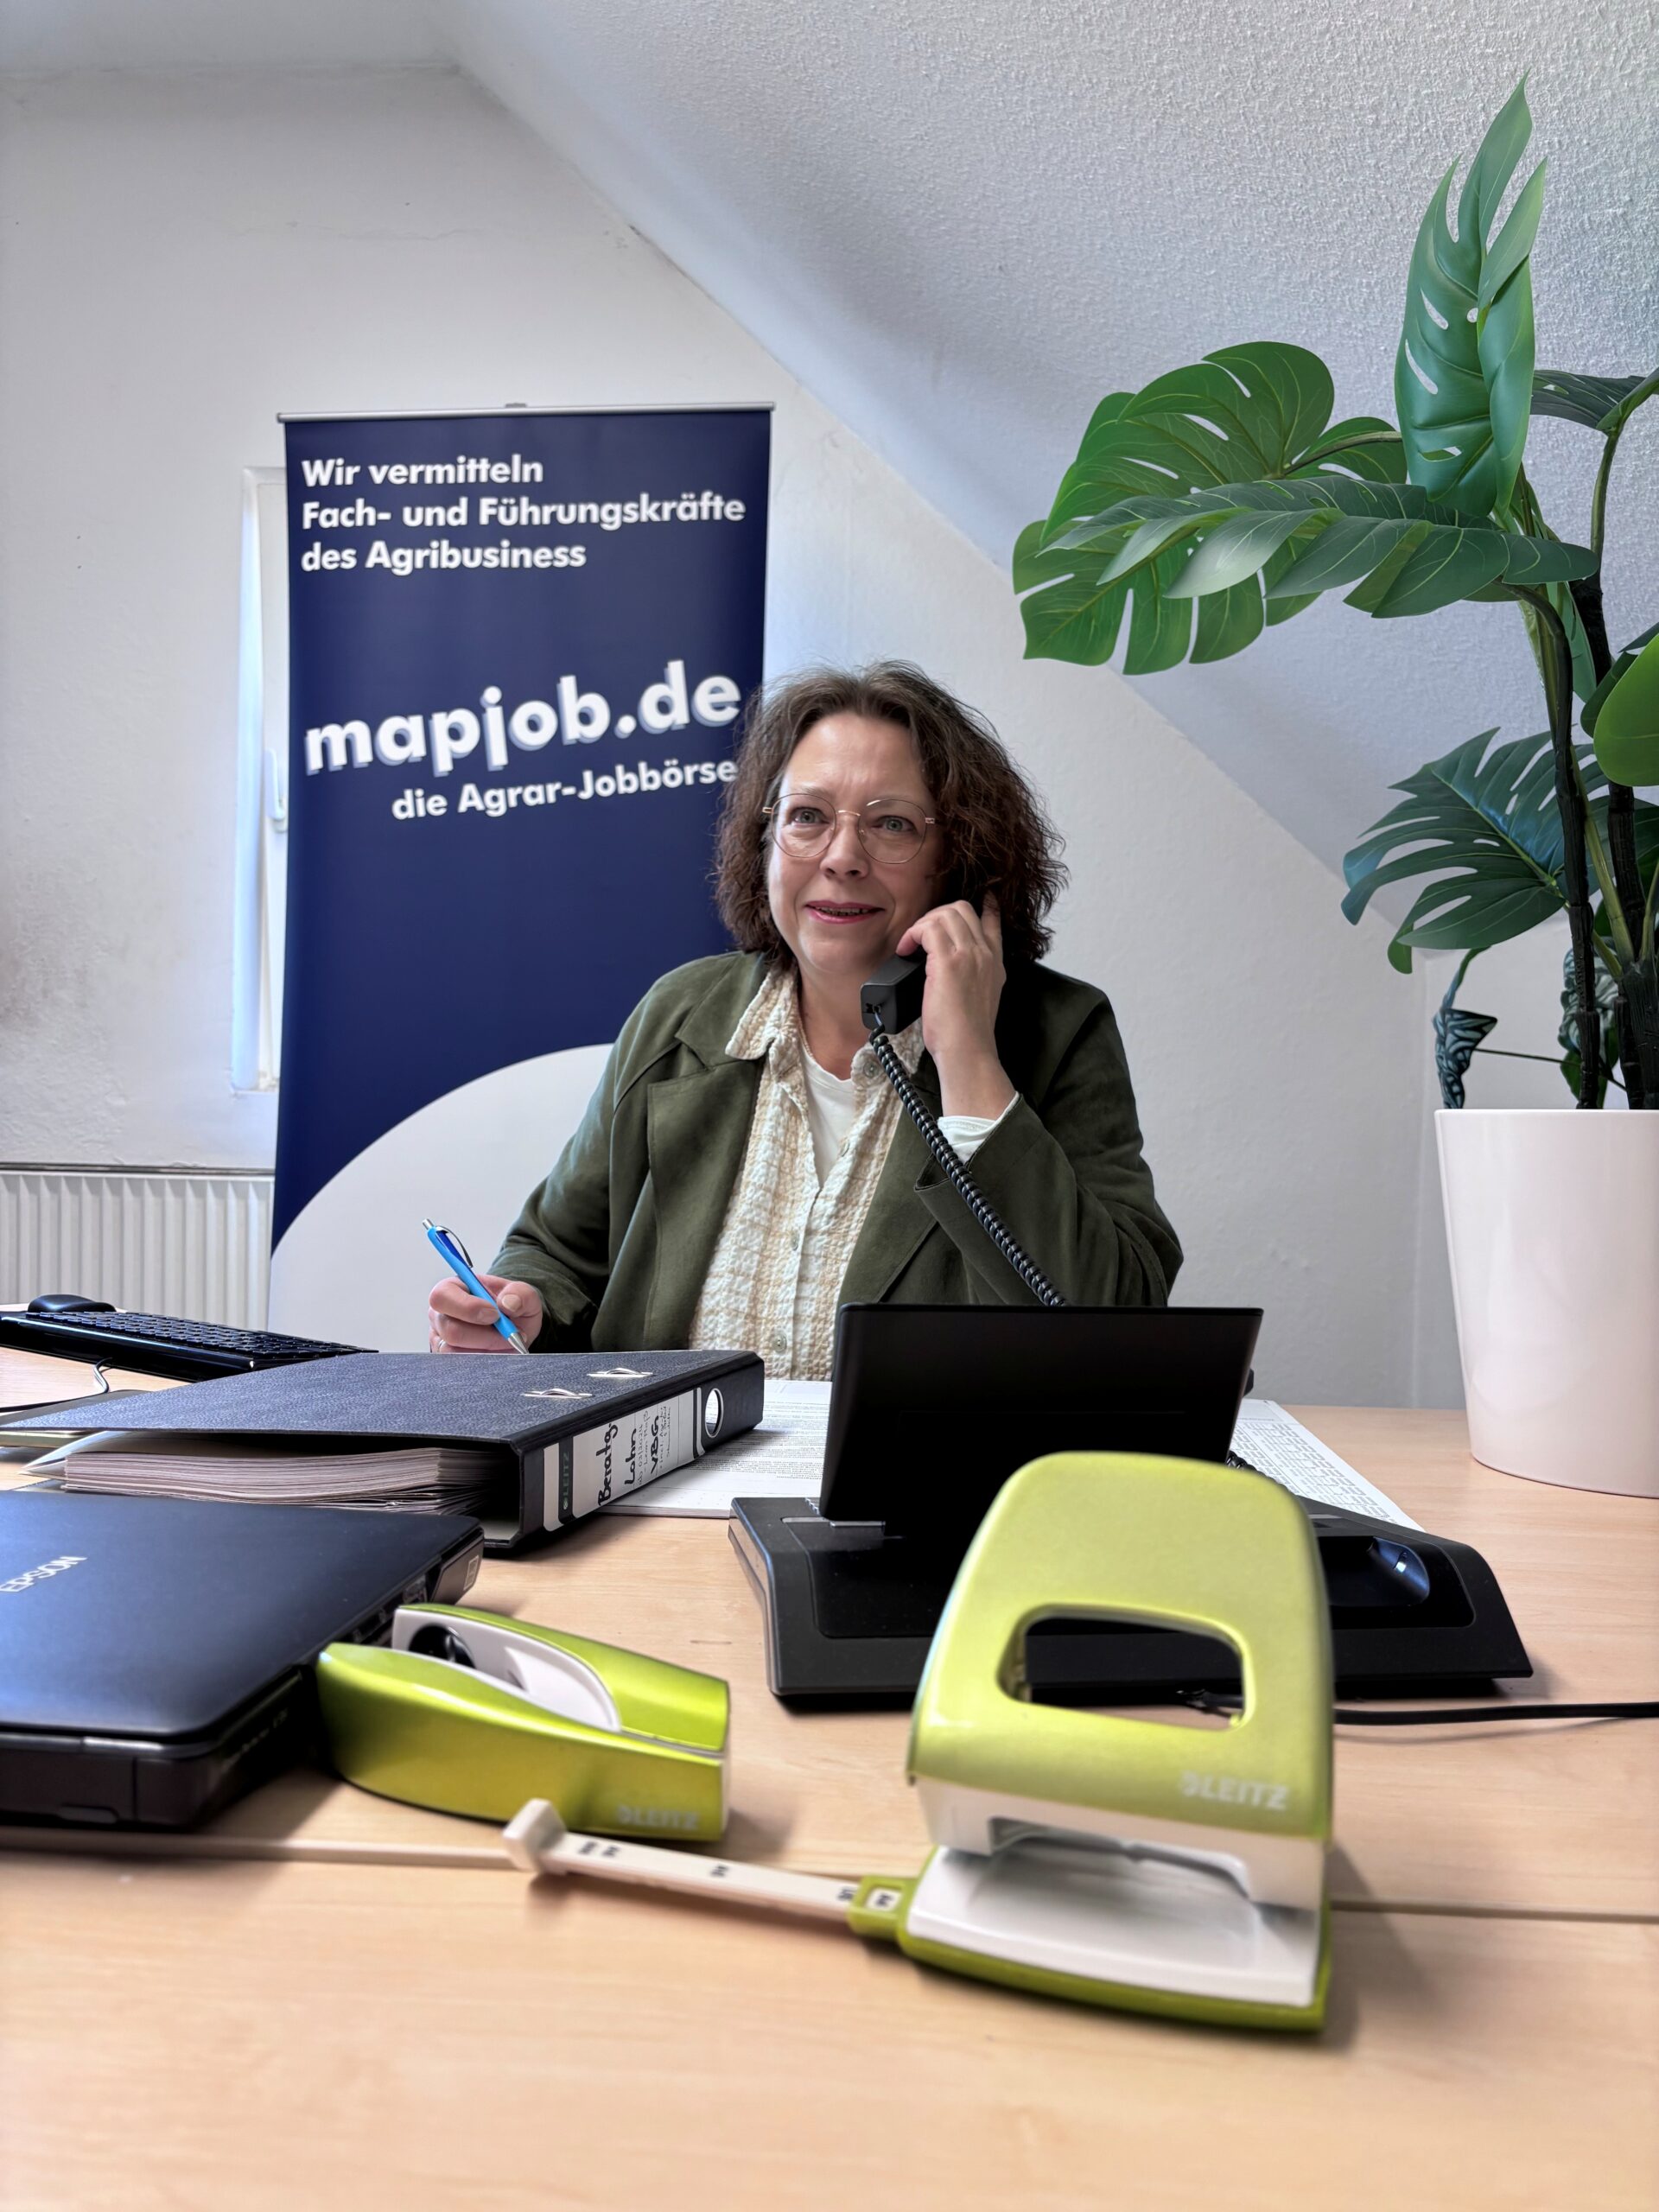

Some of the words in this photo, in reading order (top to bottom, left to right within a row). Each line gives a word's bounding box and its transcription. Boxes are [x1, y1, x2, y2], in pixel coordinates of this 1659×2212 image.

[302, 457, 360, 486] Wir
[368, 454, 543, 484] vermitteln
[302, 498, 391, 529] Fach-
[403, 497, 467, 526] und
[480, 491, 746, 531] Führungskräfte
[302, 542, 357, 571] des
[365, 539, 587, 575] Agribusiness
[305, 659, 741, 778] mapjob.de
[391, 789, 448, 820] die
[458, 759, 738, 817] Agrar-Jobbörse
[651, 1415, 659, 1474] VBG
[0, 1556, 87, 1592] EPSON
